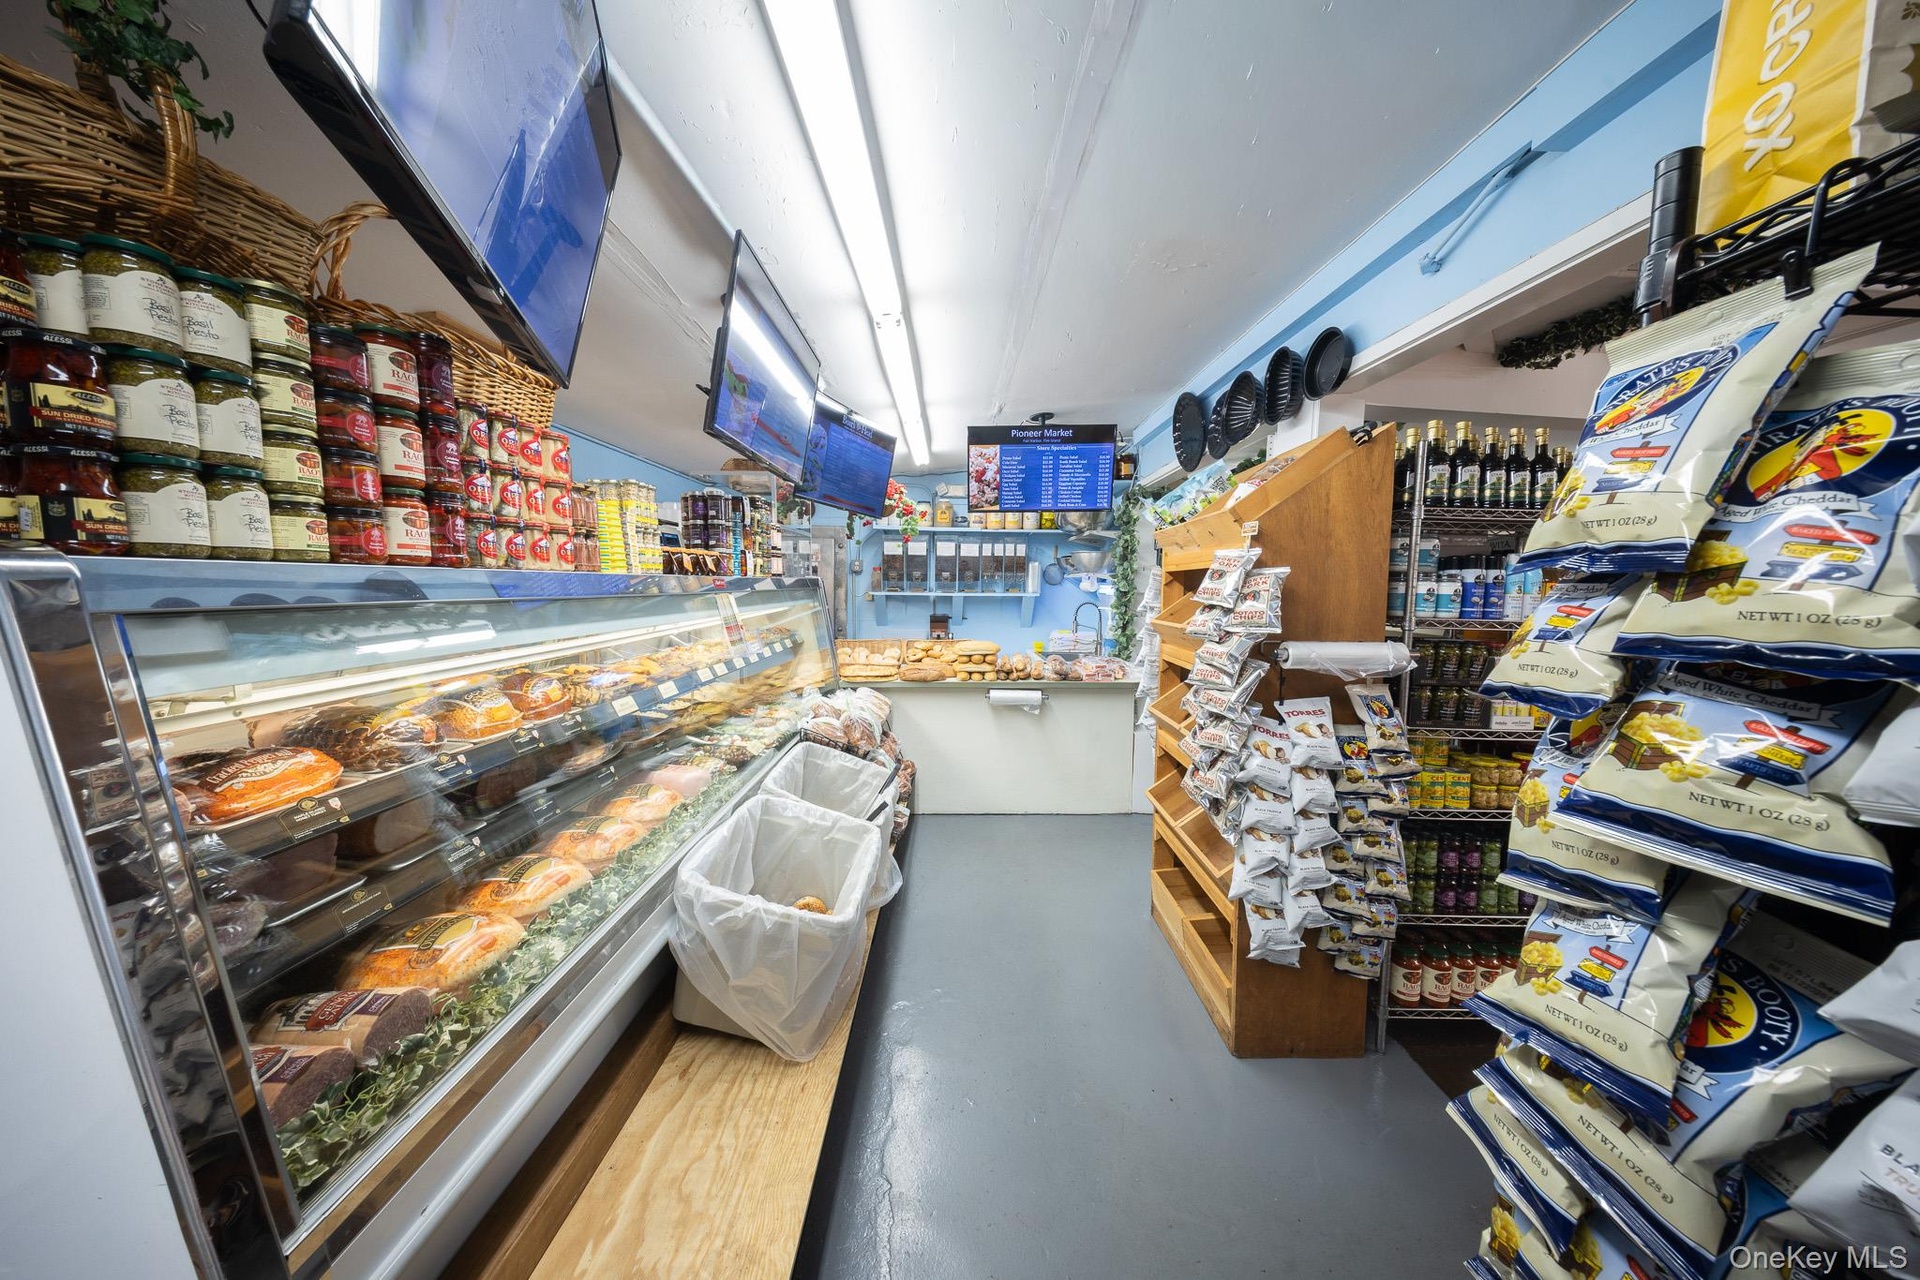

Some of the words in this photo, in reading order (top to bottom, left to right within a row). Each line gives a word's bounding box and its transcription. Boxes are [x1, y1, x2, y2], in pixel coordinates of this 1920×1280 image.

[144, 308, 178, 327] Pesto
[182, 316, 214, 329] Basil
[182, 325, 220, 340] Pesto
[41, 409, 61, 417] SUN
[63, 411, 92, 422] DRIED
[1011, 428, 1042, 438] Pioneer
[1044, 428, 1073, 437] Market
[1717, 504, 1751, 518] Aged
[1781, 493, 1852, 508] Cheddar
[1596, 519, 1611, 529] WT
[1618, 516, 1632, 526] OZ
[1646, 515, 1658, 526] g)
[1738, 610, 1766, 621] NET
[1768, 611, 1793, 623] WT
[1796, 612, 1802, 623] 1
[1806, 614, 1832, 625] OZ
[1863, 616, 1882, 629] g)
[1545, 666, 1556, 674] OZ
[1666, 674, 1699, 690] Aged
[1702, 677, 1742, 698] White
[1745, 692, 1814, 715] Cheddar
[1283, 708, 1326, 719] TORRES
[1252, 724, 1291, 740] TORRES
[205, 762, 243, 784] Cracked
[1689, 791, 1718, 807] NET
[1719, 799, 1746, 814] WT
[1759, 808, 1784, 821] OZ
[1788, 812, 1813, 827] (28
[1814, 818, 1831, 833] g)
[1551, 840, 1564, 851] NET
[1564, 843, 1576, 854] WT
[1581, 849, 1594, 859] OZ
[1594, 851, 1610, 862] (28
[1745, 974, 1794, 1047] BOOTY
[1544, 1004, 1562, 1020] NET
[1563, 1012, 1579, 1028] WT
[1585, 1023, 1602, 1039] OZ
[1602, 1031, 1618, 1046] (28
[1493, 1113, 1507, 1130] NET
[1520, 1142, 1533, 1159] OZ
[1577, 1114, 1602, 1137] NET
[1600, 1132, 1619, 1151] WT
[1625, 1158, 1644, 1178] OZ
[1643, 1175, 1663, 1193] (28
